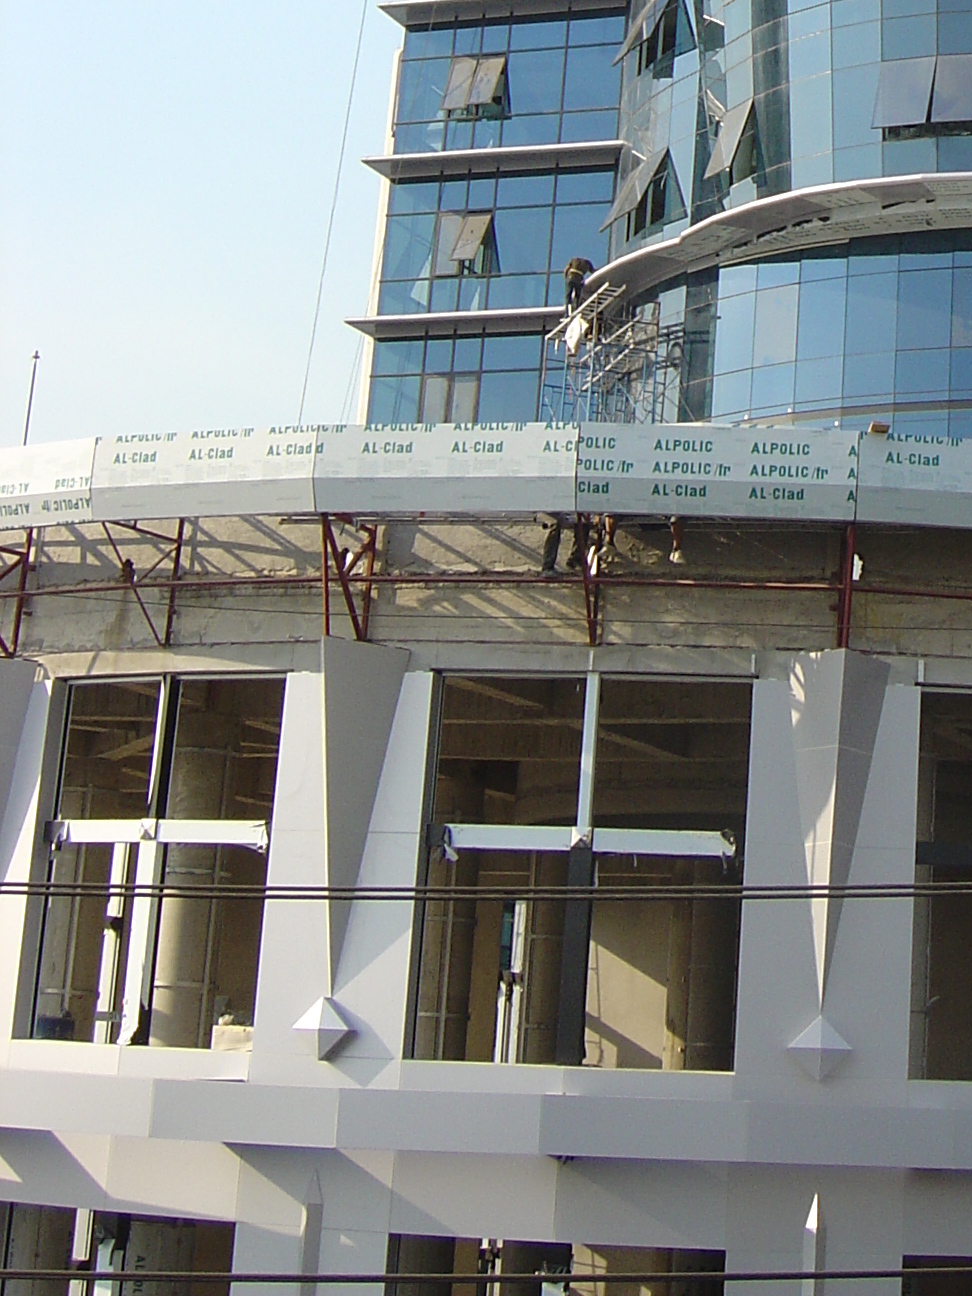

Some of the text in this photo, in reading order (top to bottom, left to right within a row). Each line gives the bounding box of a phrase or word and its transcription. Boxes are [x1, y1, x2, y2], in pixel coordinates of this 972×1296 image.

[113, 443, 312, 464] AL-Clad AL-Clad AL-Clad
[361, 441, 413, 454] AL-Clad
[451, 441, 504, 454] AL-Clad
[654, 439, 714, 453] ALPOLIC
[751, 442, 810, 456] ALPOLIC
[886, 452, 940, 466] AL-Clad
[652, 484, 707, 498] AL-Clad
[749, 487, 804, 501] AL-Clad
[133, 1256, 146, 1294] ALOL
